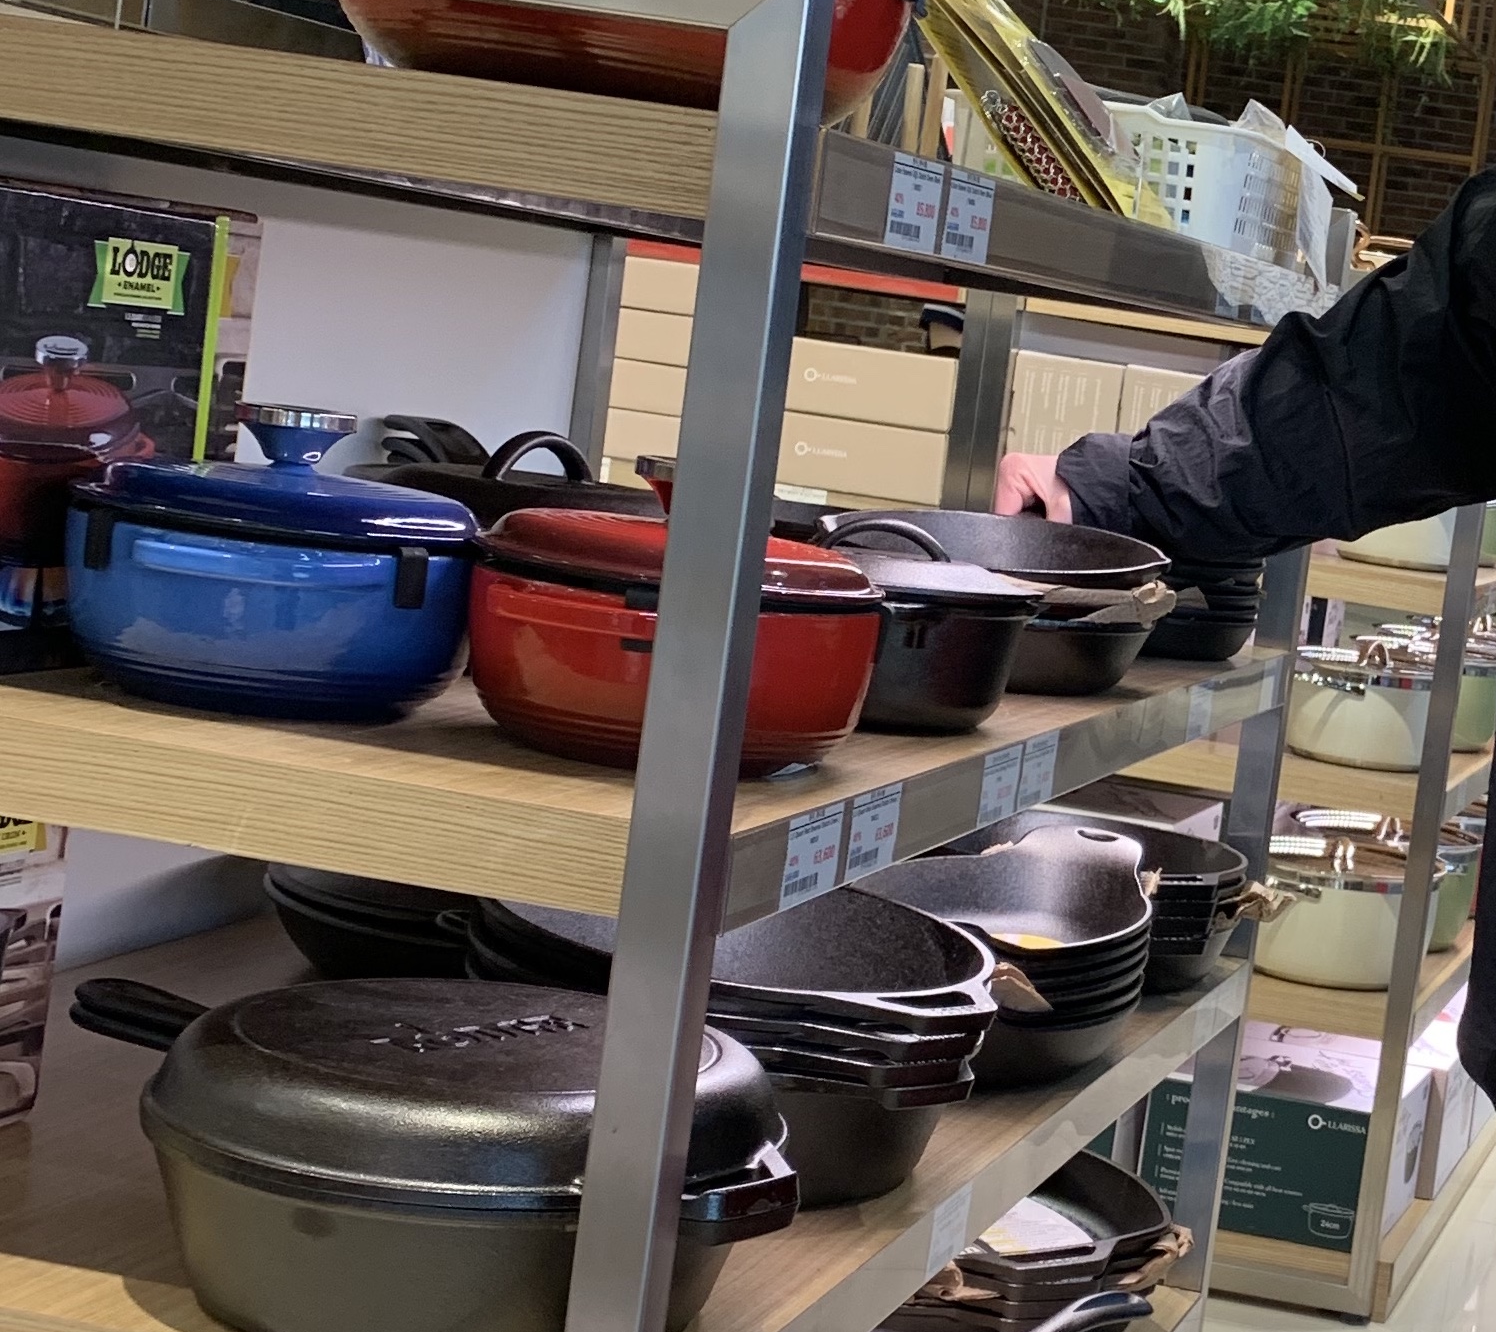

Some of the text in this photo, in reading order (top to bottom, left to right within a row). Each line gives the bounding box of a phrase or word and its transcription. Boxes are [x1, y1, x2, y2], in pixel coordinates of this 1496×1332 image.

[110, 244, 173, 281] LODGE
[123, 281, 155, 293] ENAMEL
[1327, 1121, 1367, 1135] LLARISSA
